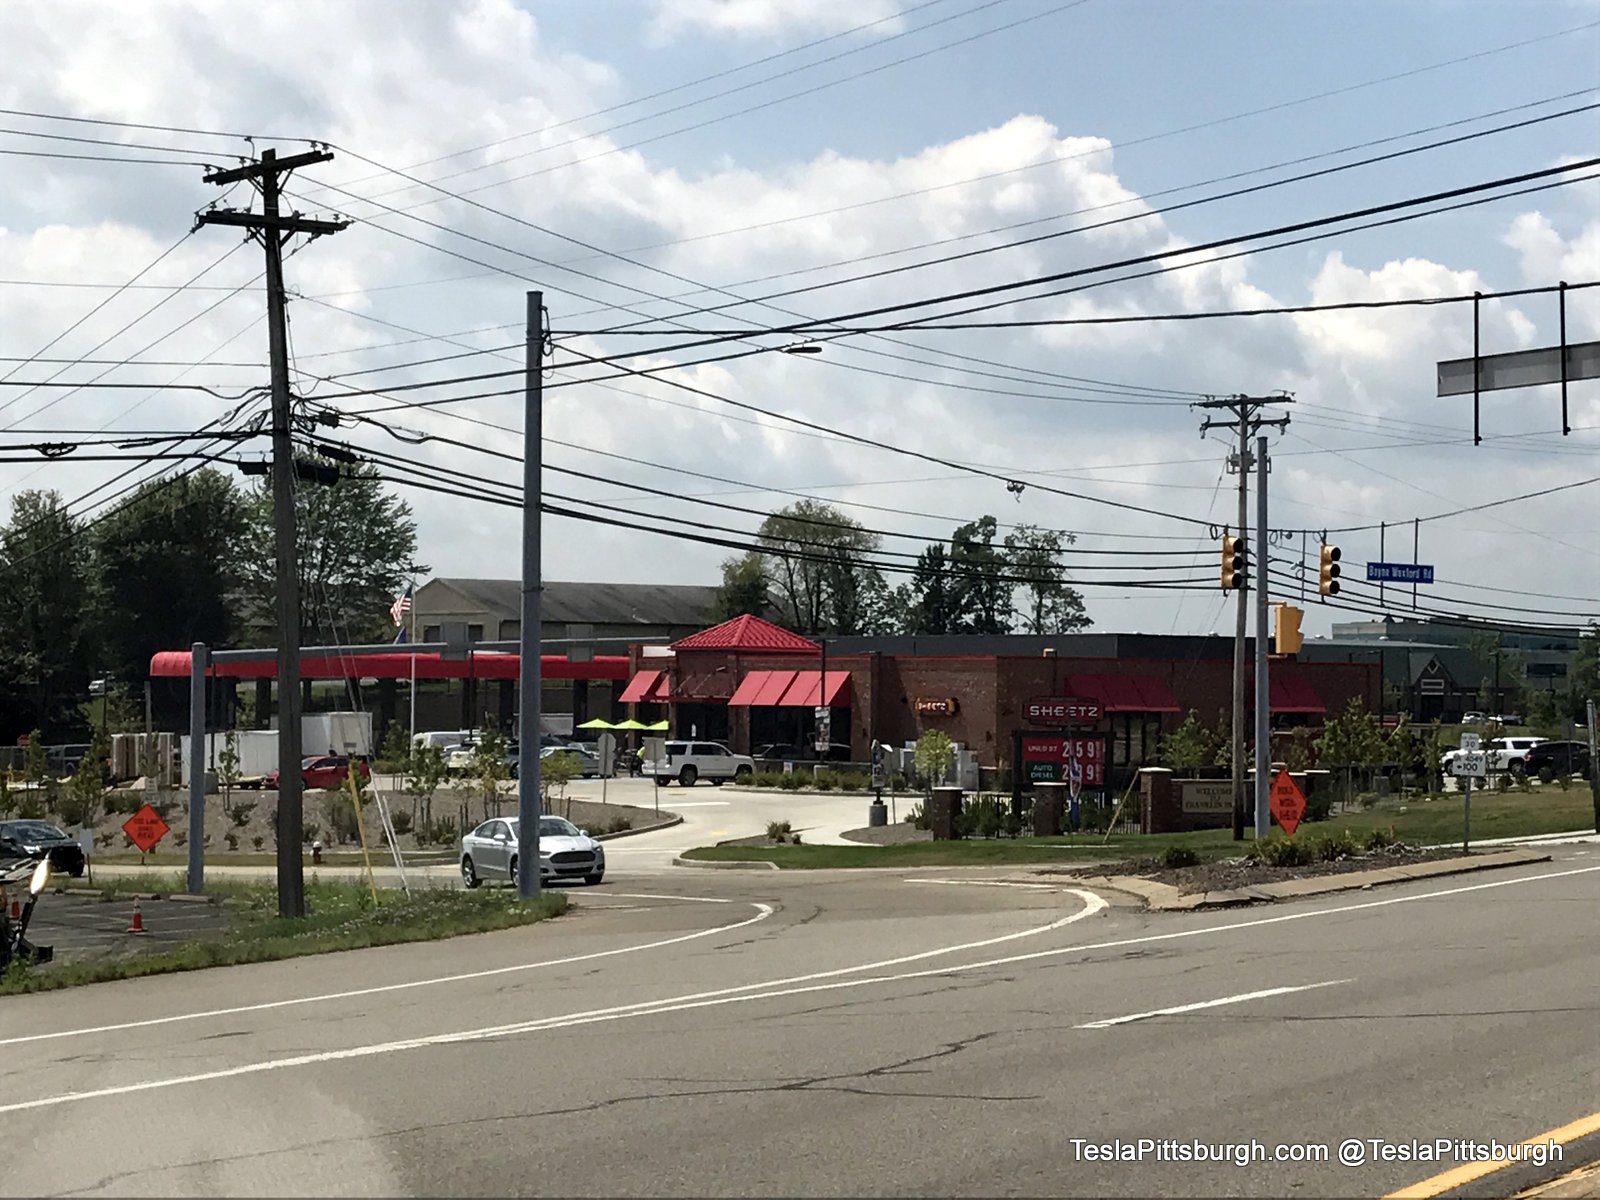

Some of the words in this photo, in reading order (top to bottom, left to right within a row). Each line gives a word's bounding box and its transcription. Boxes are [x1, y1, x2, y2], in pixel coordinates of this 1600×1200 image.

[1423, 568, 1432, 579] Rd
[1029, 705, 1098, 717] SHEETZ
[1463, 763, 1478, 771] 100
